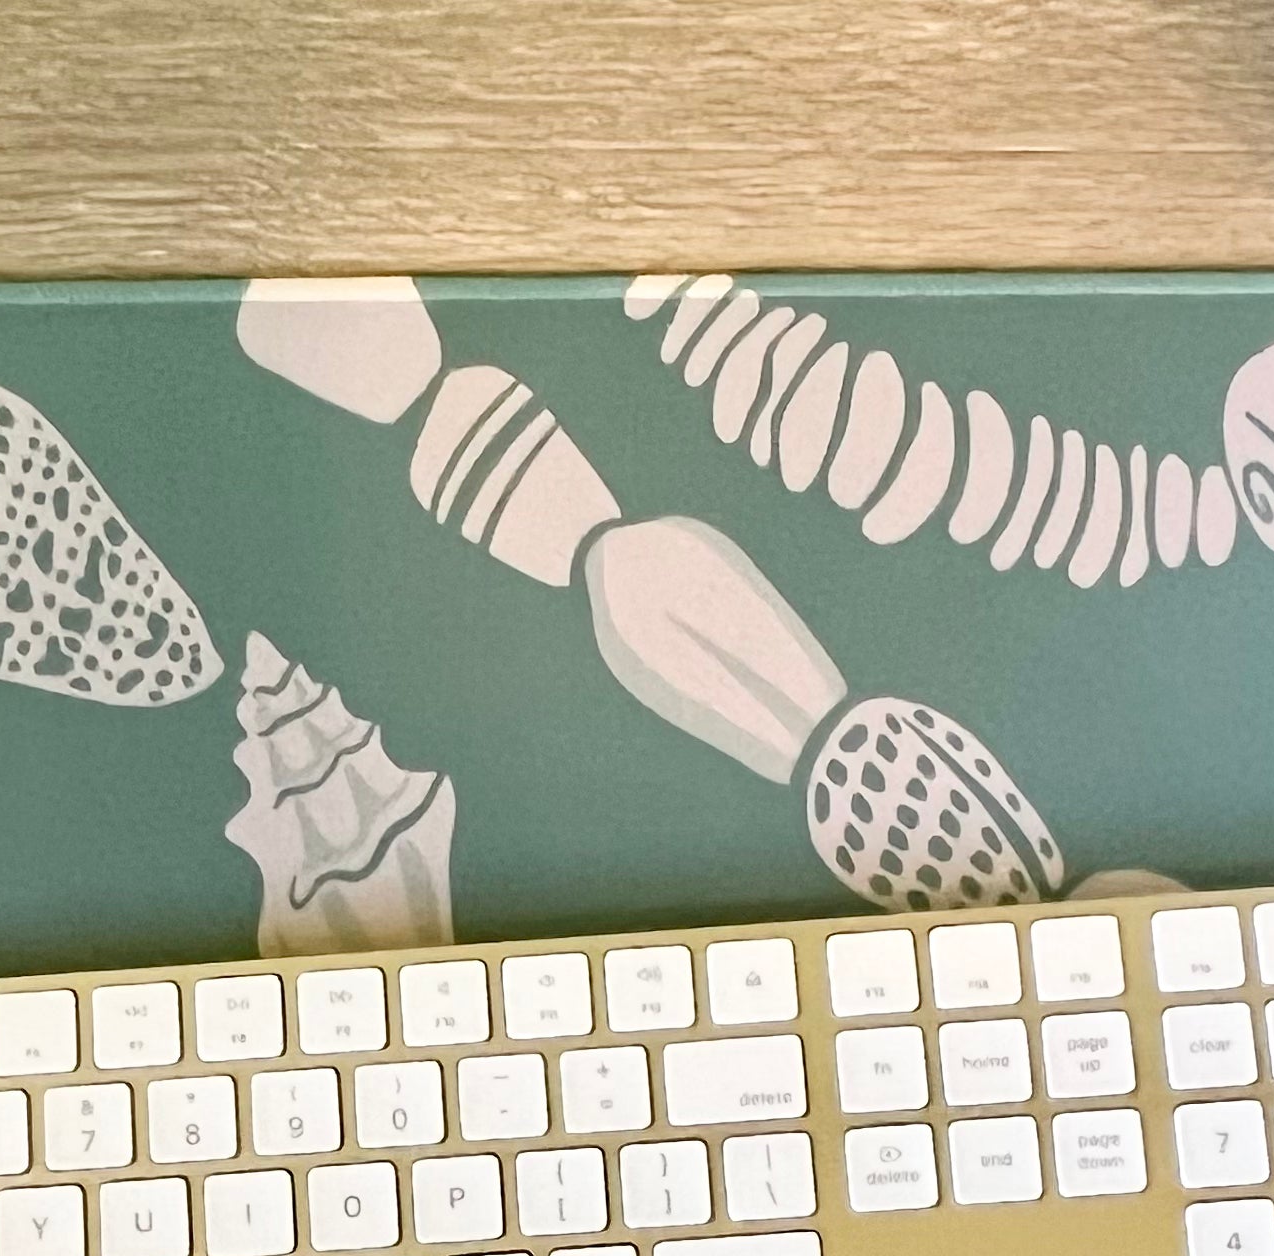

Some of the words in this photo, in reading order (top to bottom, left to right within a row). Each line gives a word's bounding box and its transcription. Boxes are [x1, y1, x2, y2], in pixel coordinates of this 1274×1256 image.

[288, 1116, 304, 1139] 9
[391, 1107, 408, 1131] 0
[80, 1129, 96, 1153] 7
[185, 1123, 201, 1146] 8
[1215, 1131, 1230, 1154] 7
[343, 1195, 362, 1218] O
[449, 1187, 466, 1209] P
[31, 1216, 49, 1240] Y
[134, 1210, 153, 1233] U
[1226, 1231, 1243, 1252] 4
